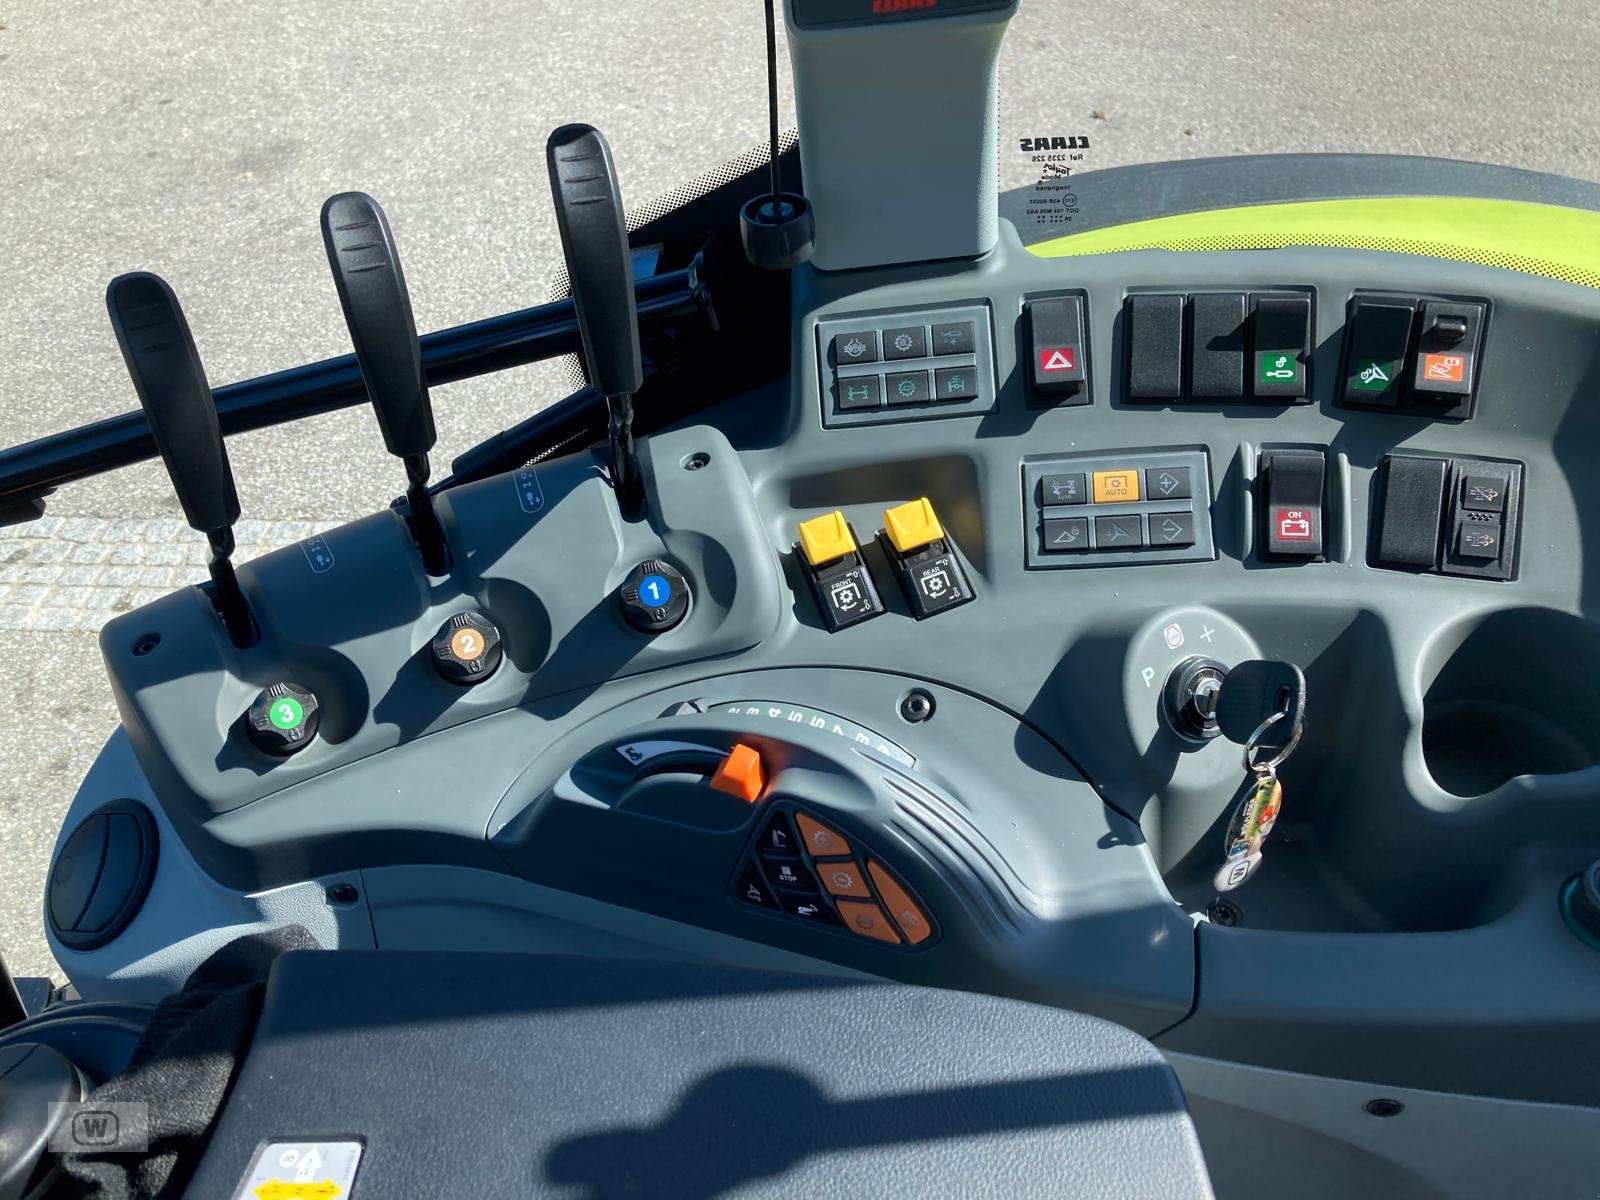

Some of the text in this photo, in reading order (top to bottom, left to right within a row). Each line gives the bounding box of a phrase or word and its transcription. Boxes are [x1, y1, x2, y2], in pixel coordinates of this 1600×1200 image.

[1105, 488, 1127, 496] AUTO
[1288, 511, 1302, 519] ON
[922, 566, 941, 578] REAR
[831, 577, 852, 590] FRONT
[647, 582, 660, 600] 1
[460, 635, 477, 654] 2
[1141, 666, 1155, 688] P
[278, 704, 295, 723] 3
[787, 710, 803, 723] 5
[779, 874, 797, 882] STOP
